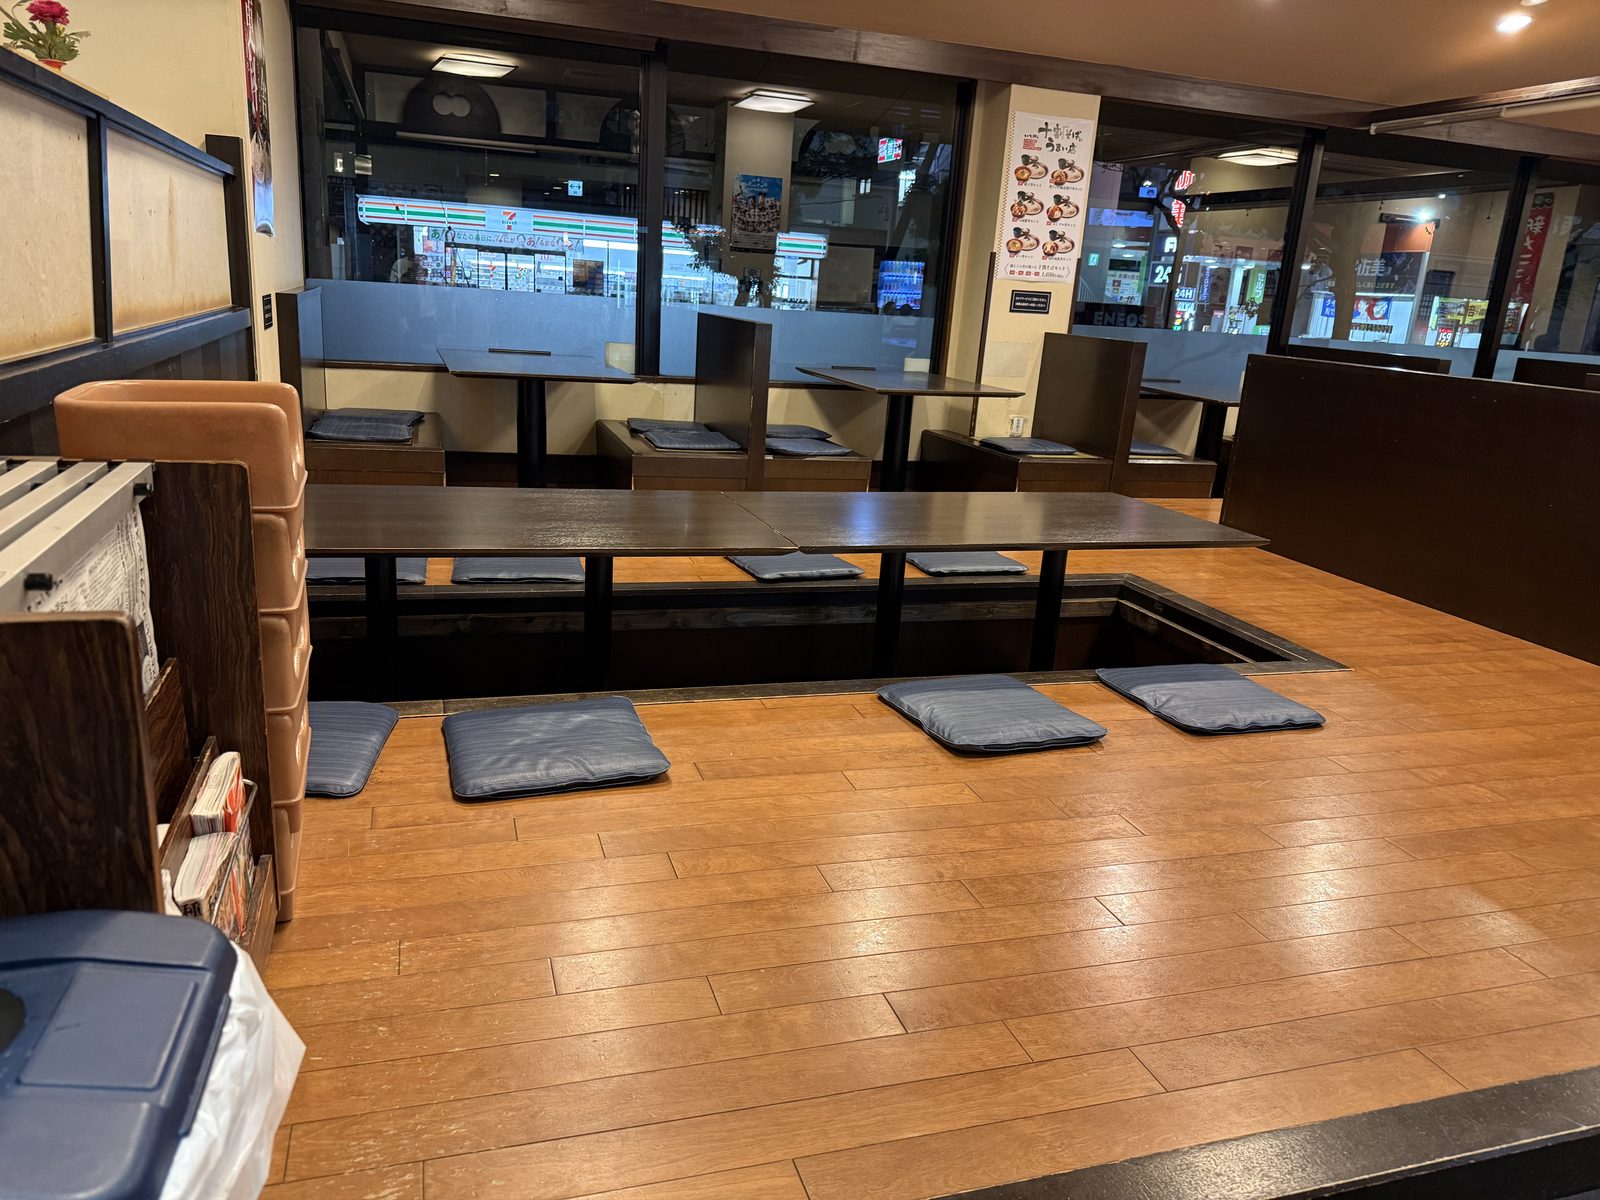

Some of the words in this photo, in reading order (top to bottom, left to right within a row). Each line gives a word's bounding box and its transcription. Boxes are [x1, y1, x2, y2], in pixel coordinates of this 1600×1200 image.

[1174, 288, 1193, 298] 24H
[1093, 311, 1148, 327] ENEOS
[1438, 332, 1452, 342] 159
